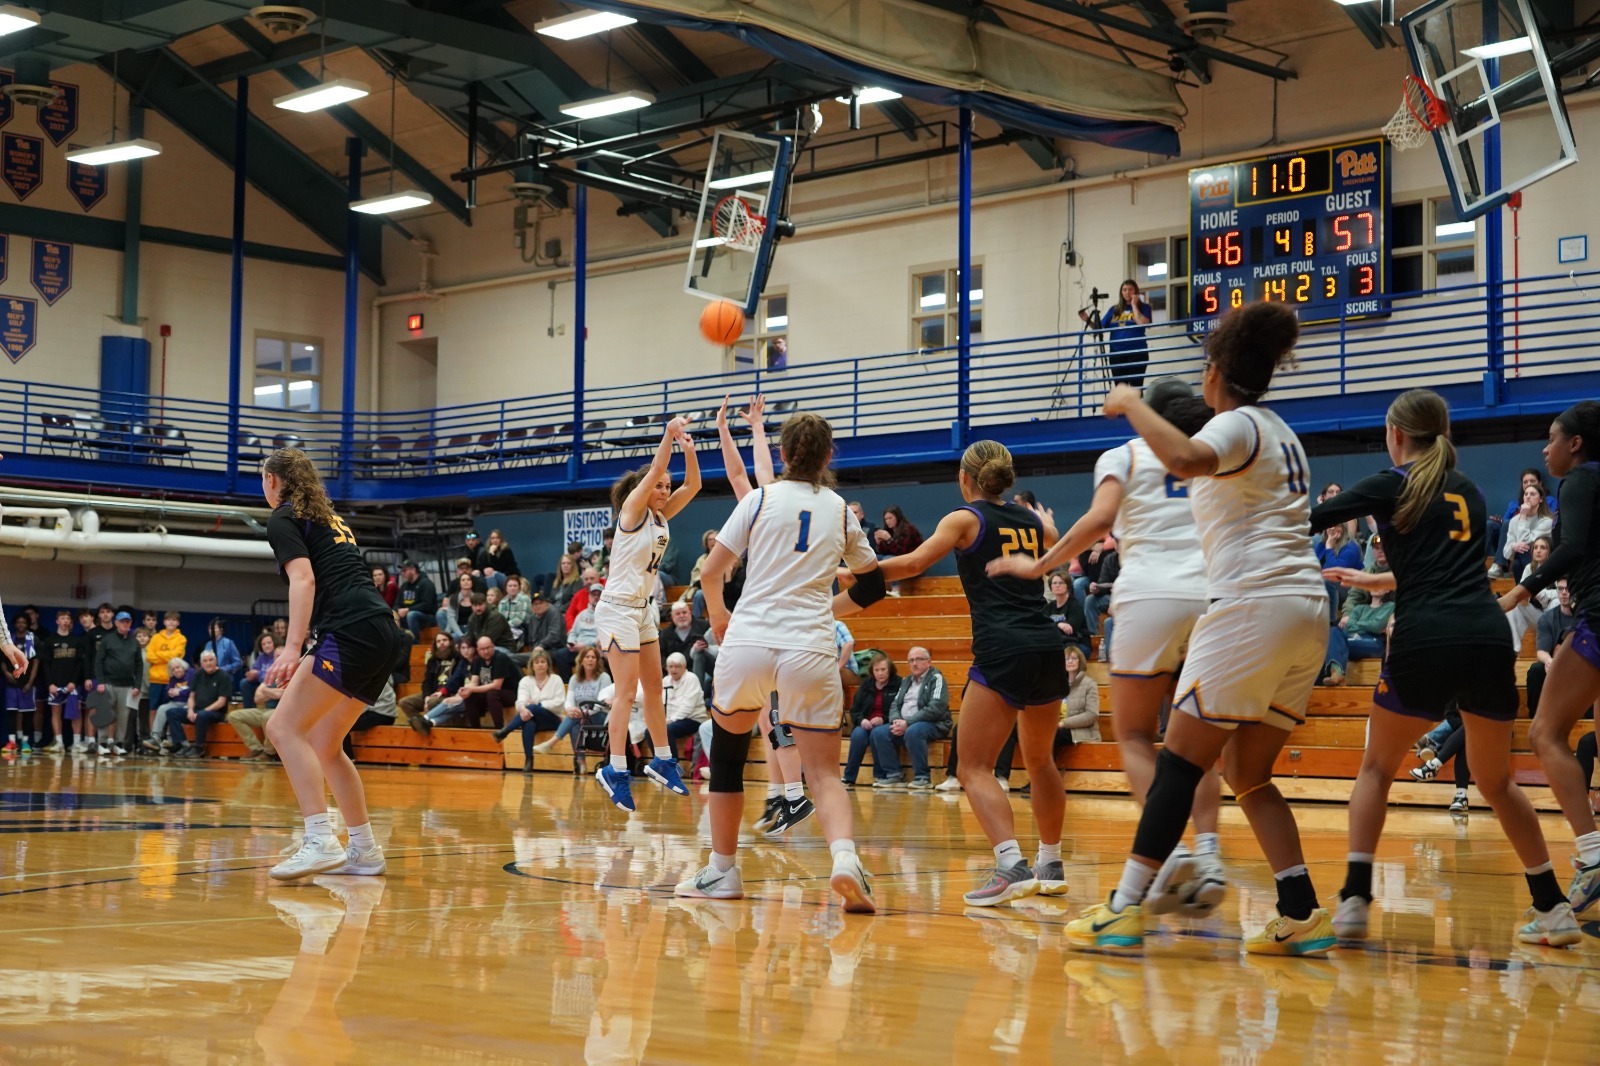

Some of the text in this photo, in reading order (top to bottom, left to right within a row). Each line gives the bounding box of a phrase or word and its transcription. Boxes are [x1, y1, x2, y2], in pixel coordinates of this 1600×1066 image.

[1336, 150, 1377, 178] Pitt
[1194, 173, 1231, 199] Pitt
[1252, 157, 1305, 196] 11.0
[1325, 189, 1371, 212] GUEST
[1200, 209, 1238, 230] HOME
[1266, 210, 1300, 226] PERIOD
[1276, 229, 1290, 252] 4
[1334, 212, 1373, 251] 57
[1206, 231, 1241, 265] 46
[1346, 251, 1377, 266] FOULS
[1193, 272, 1222, 286] FOULS
[1253, 260, 1315, 278] PLAYER FOUL
[1321, 265, 1339, 276] T.O.L.
[1360, 266, 1373, 295] 3
[1228, 278, 1246, 287] T.O.L.
[1264, 279, 1286, 302] 14
[1296, 274, 1310, 302] 2
[1326, 276, 1336, 297] 3
[1204, 286, 1218, 313] 5
[1231, 288, 1242, 308] 0
[1346, 300, 1378, 314] SCORE
[1281, 442, 1308, 494] 11
[567, 510, 609, 529] VISITORS
[1444, 492, 1471, 542] 3
[567, 528, 605, 548] SECTIO
[794, 510, 812, 552] 1
[998, 527, 1039, 561] 24
